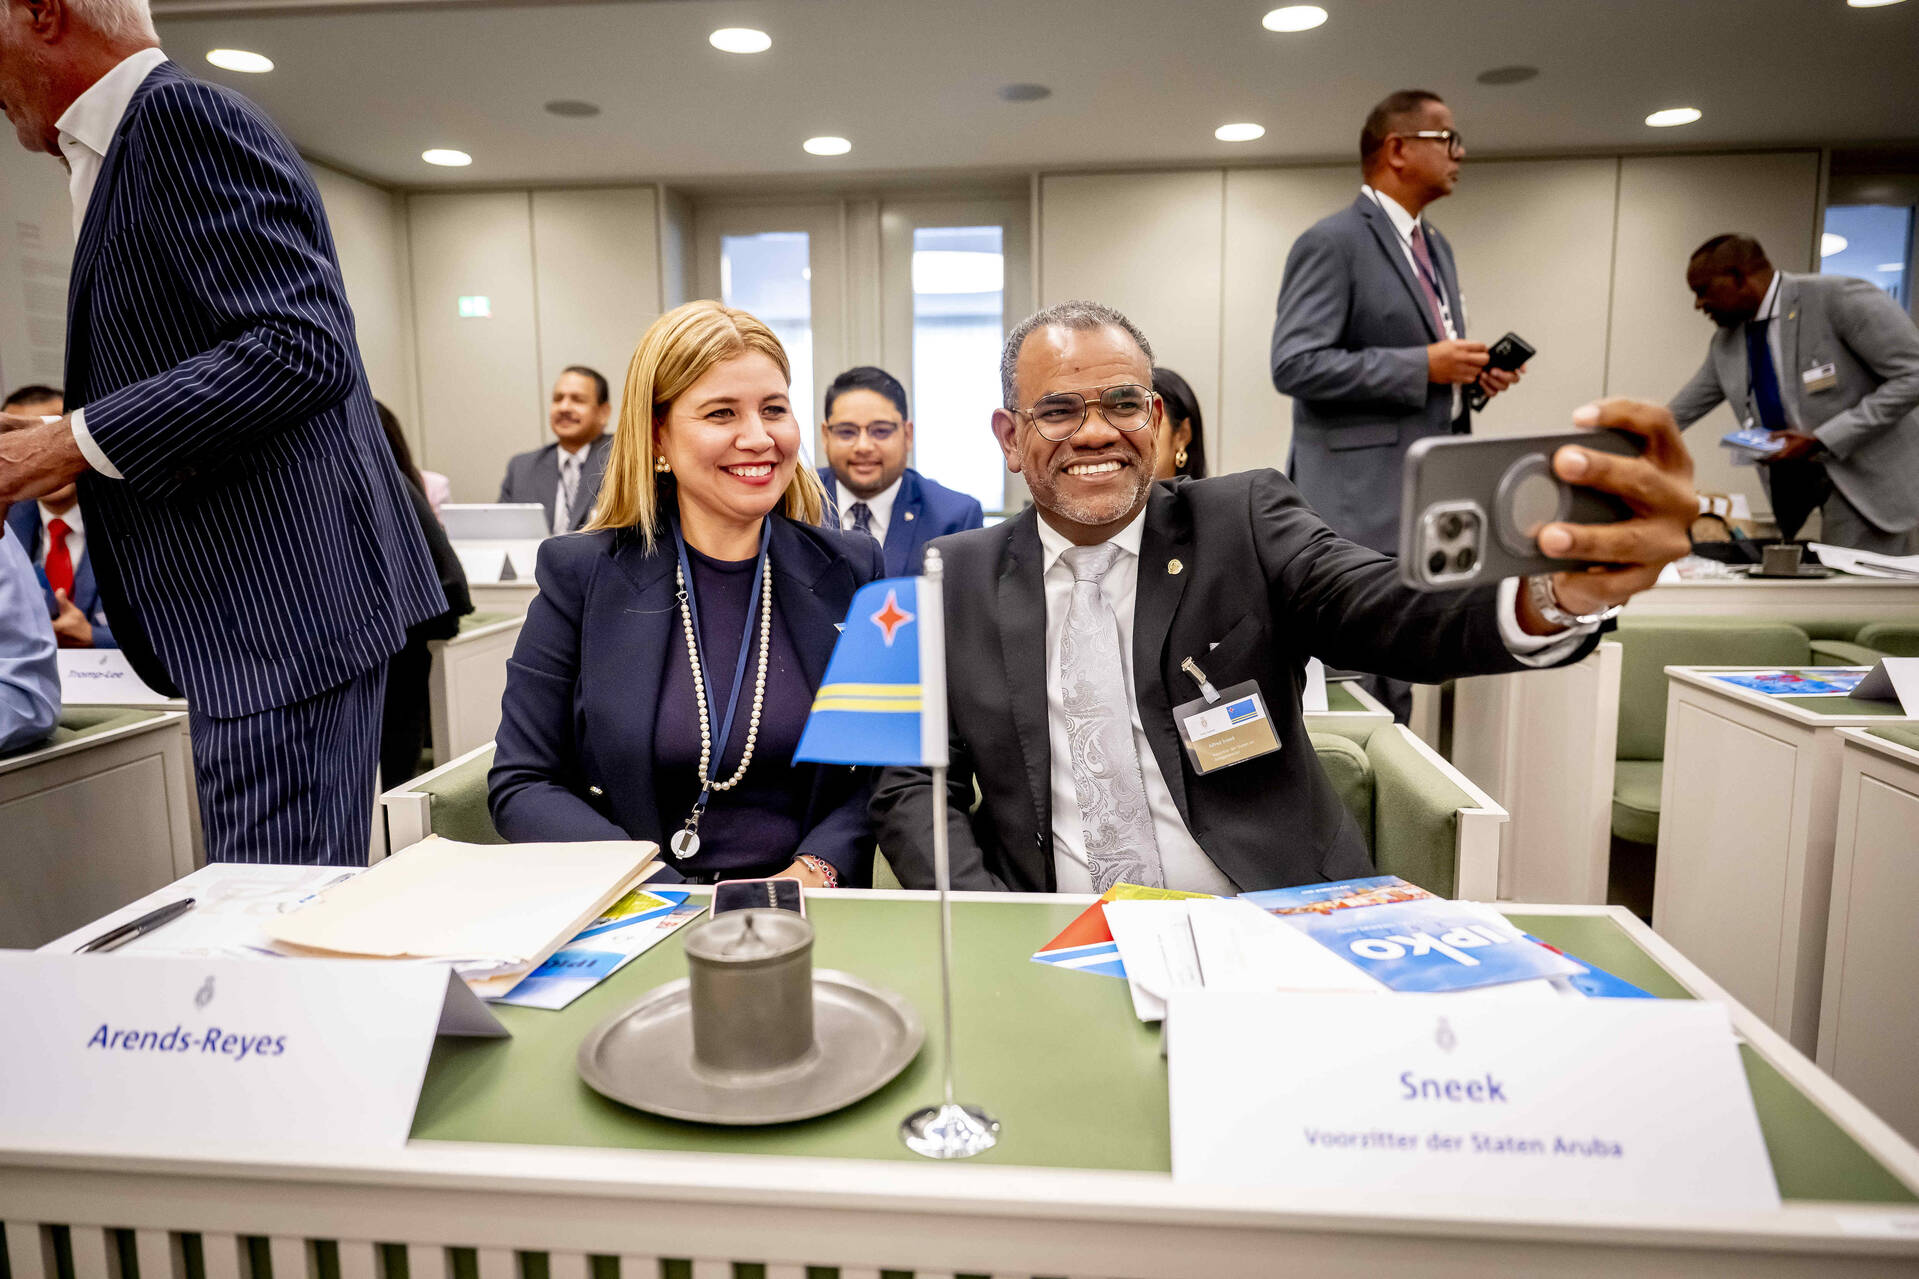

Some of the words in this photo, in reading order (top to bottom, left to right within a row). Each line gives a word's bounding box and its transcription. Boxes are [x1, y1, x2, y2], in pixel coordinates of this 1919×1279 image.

[87, 1023, 287, 1062] Arends-Reyes
[1399, 1071, 1507, 1103] Sneek
[1303, 1126, 1419, 1150] Voorzitter
[1426, 1131, 1463, 1152] der
[1471, 1132, 1547, 1155] Staten
[1554, 1135, 1624, 1159] Aruba
